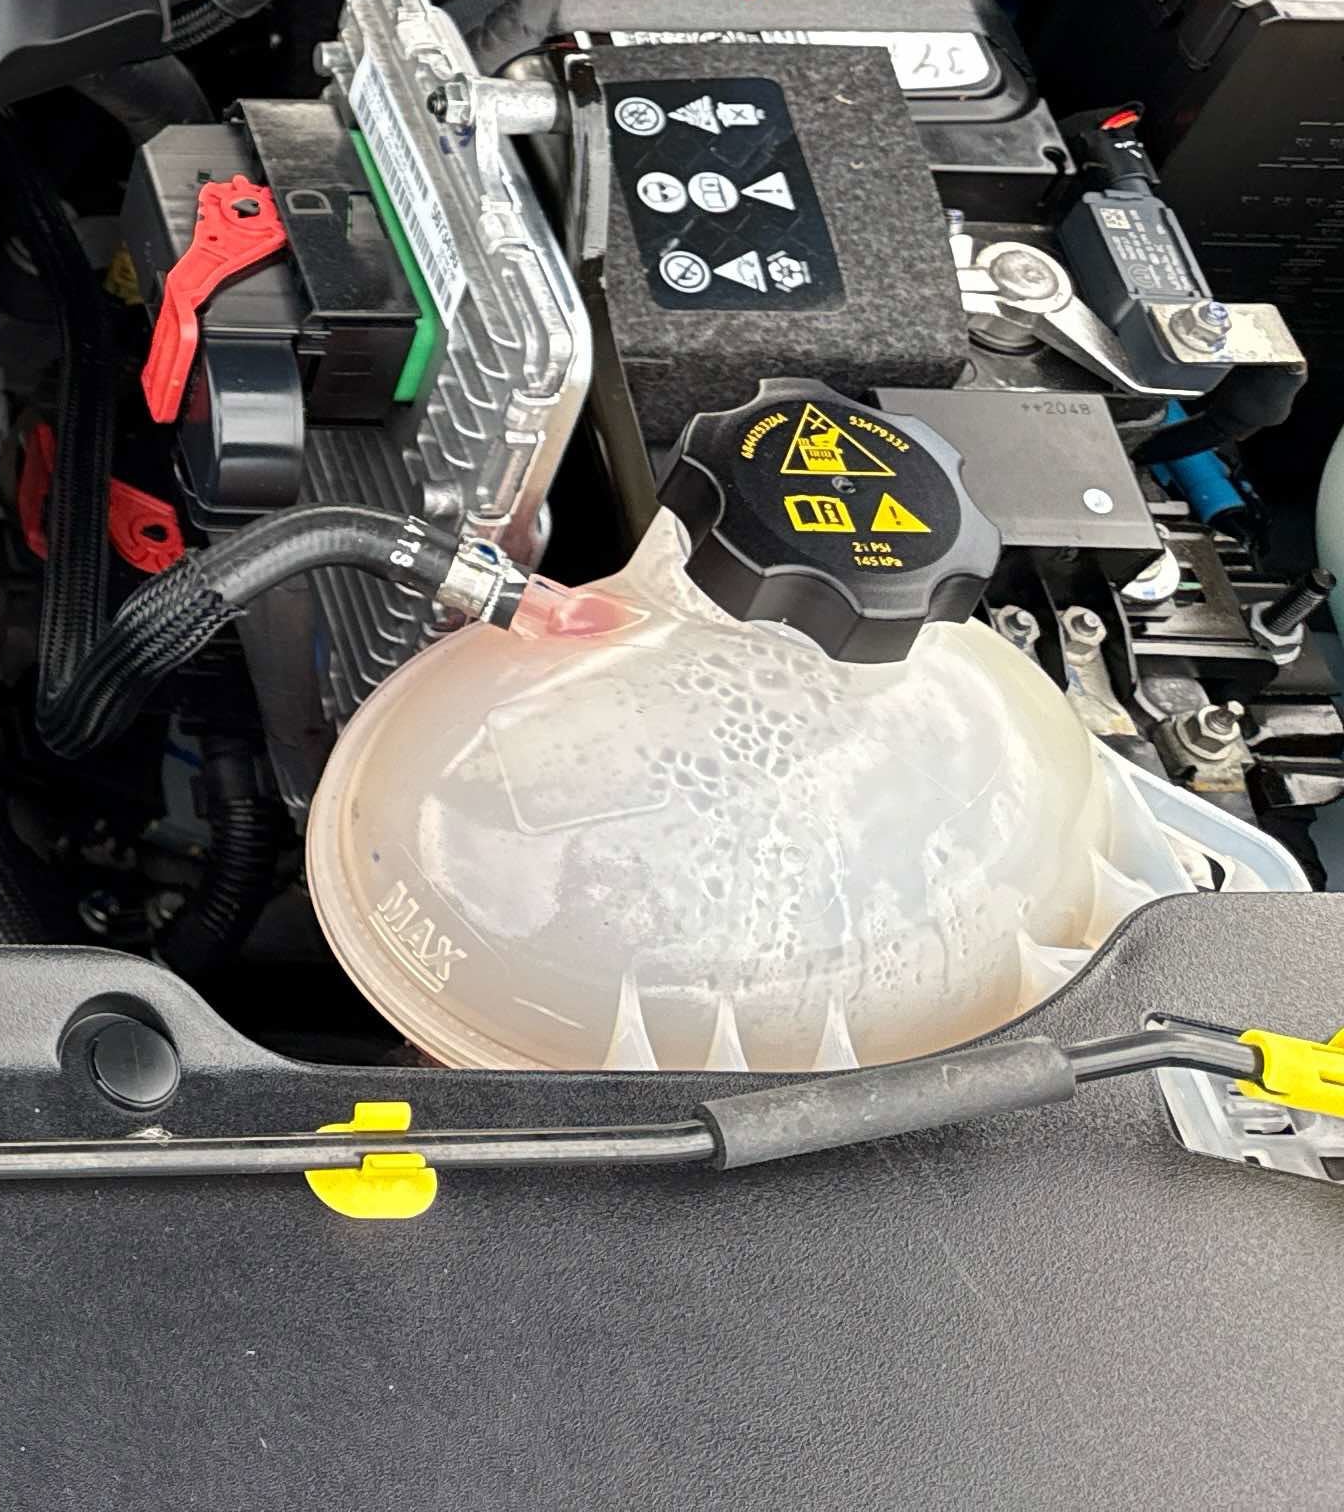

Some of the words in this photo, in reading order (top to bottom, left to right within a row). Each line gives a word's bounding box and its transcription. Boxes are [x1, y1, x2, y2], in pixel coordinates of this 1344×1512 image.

[869, 541, 892, 553] PSI
[879, 555, 904, 567] kPa
[376, 879, 469, 982] MAX
